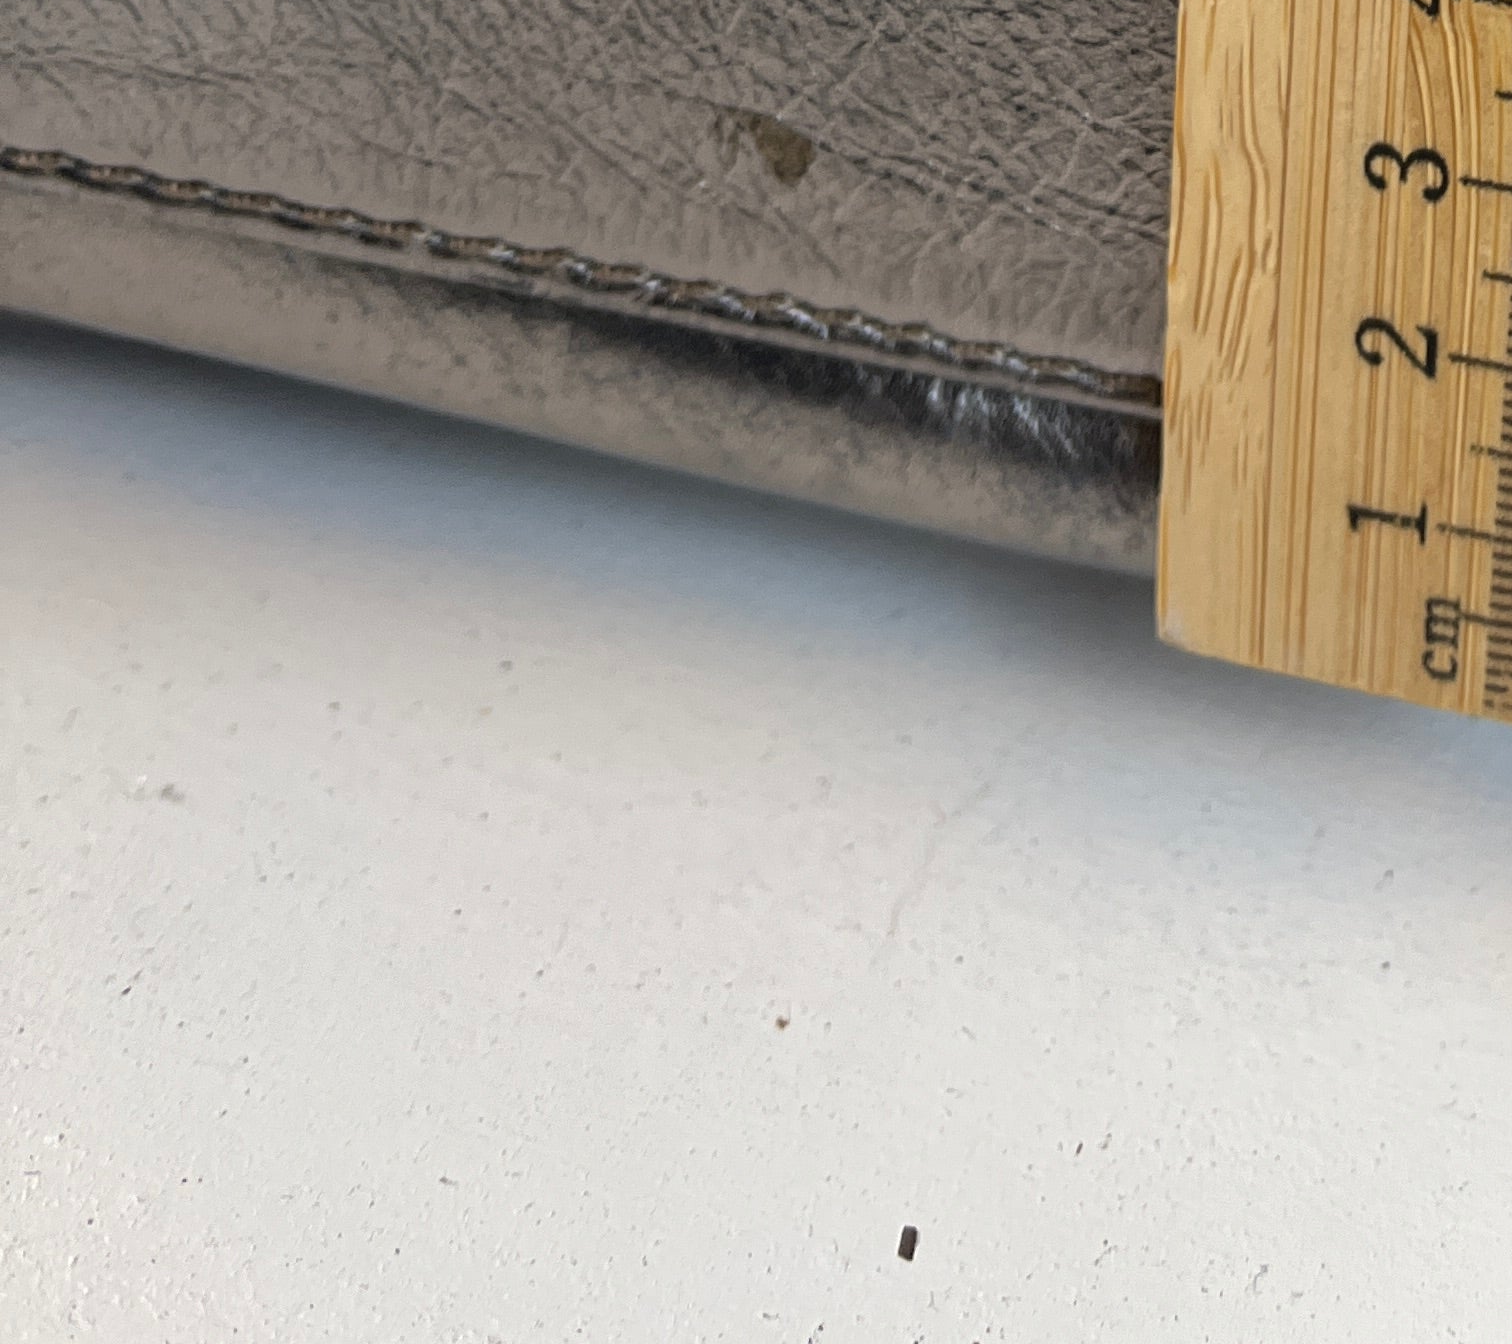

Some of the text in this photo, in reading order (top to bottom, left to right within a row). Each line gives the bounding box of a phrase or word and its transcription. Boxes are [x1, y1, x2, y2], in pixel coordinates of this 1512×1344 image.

[1363, 141, 1451, 205] 3
[1353, 316, 1440, 380] 2
[1345, 501, 1429, 547] 1
[1421, 595, 1462, 683] cm
